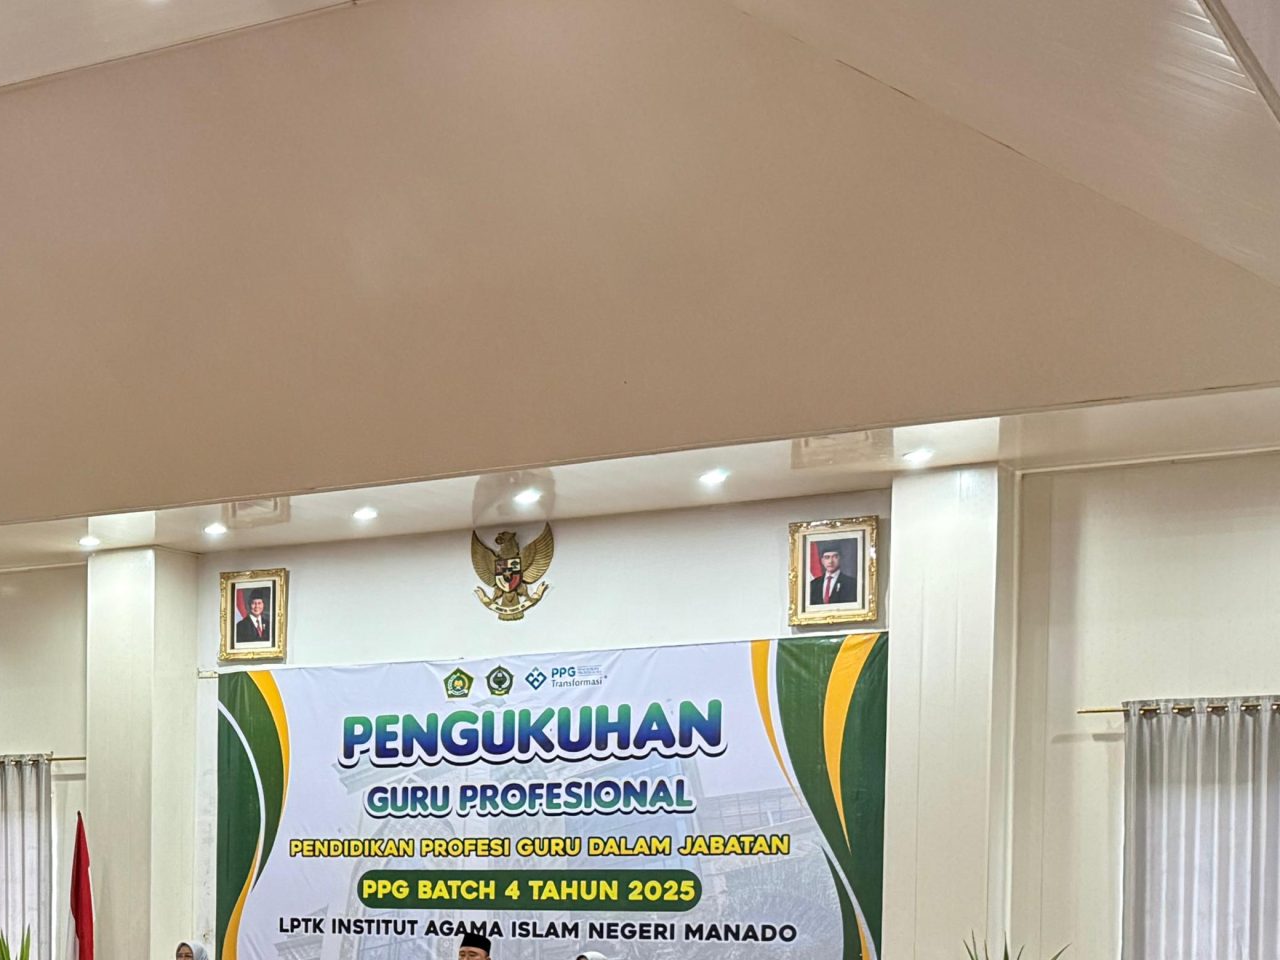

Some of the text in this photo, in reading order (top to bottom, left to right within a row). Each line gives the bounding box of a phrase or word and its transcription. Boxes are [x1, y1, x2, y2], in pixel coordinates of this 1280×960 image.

[551, 666, 576, 678] PPG
[551, 678, 603, 688] Transformasi
[341, 698, 723, 763] PENGUKUHAN
[367, 778, 694, 814] GURU PROFESIONAL
[289, 834, 791, 857] PENDIDIKAN PROFESI GURU DALAM JABATAN
[362, 879, 695, 901] PPG BATCH 4 TAHUN 2025
[279, 917, 797, 943] LPTK INSTITUT AGAMA ISLAM NEGERI MANADO
